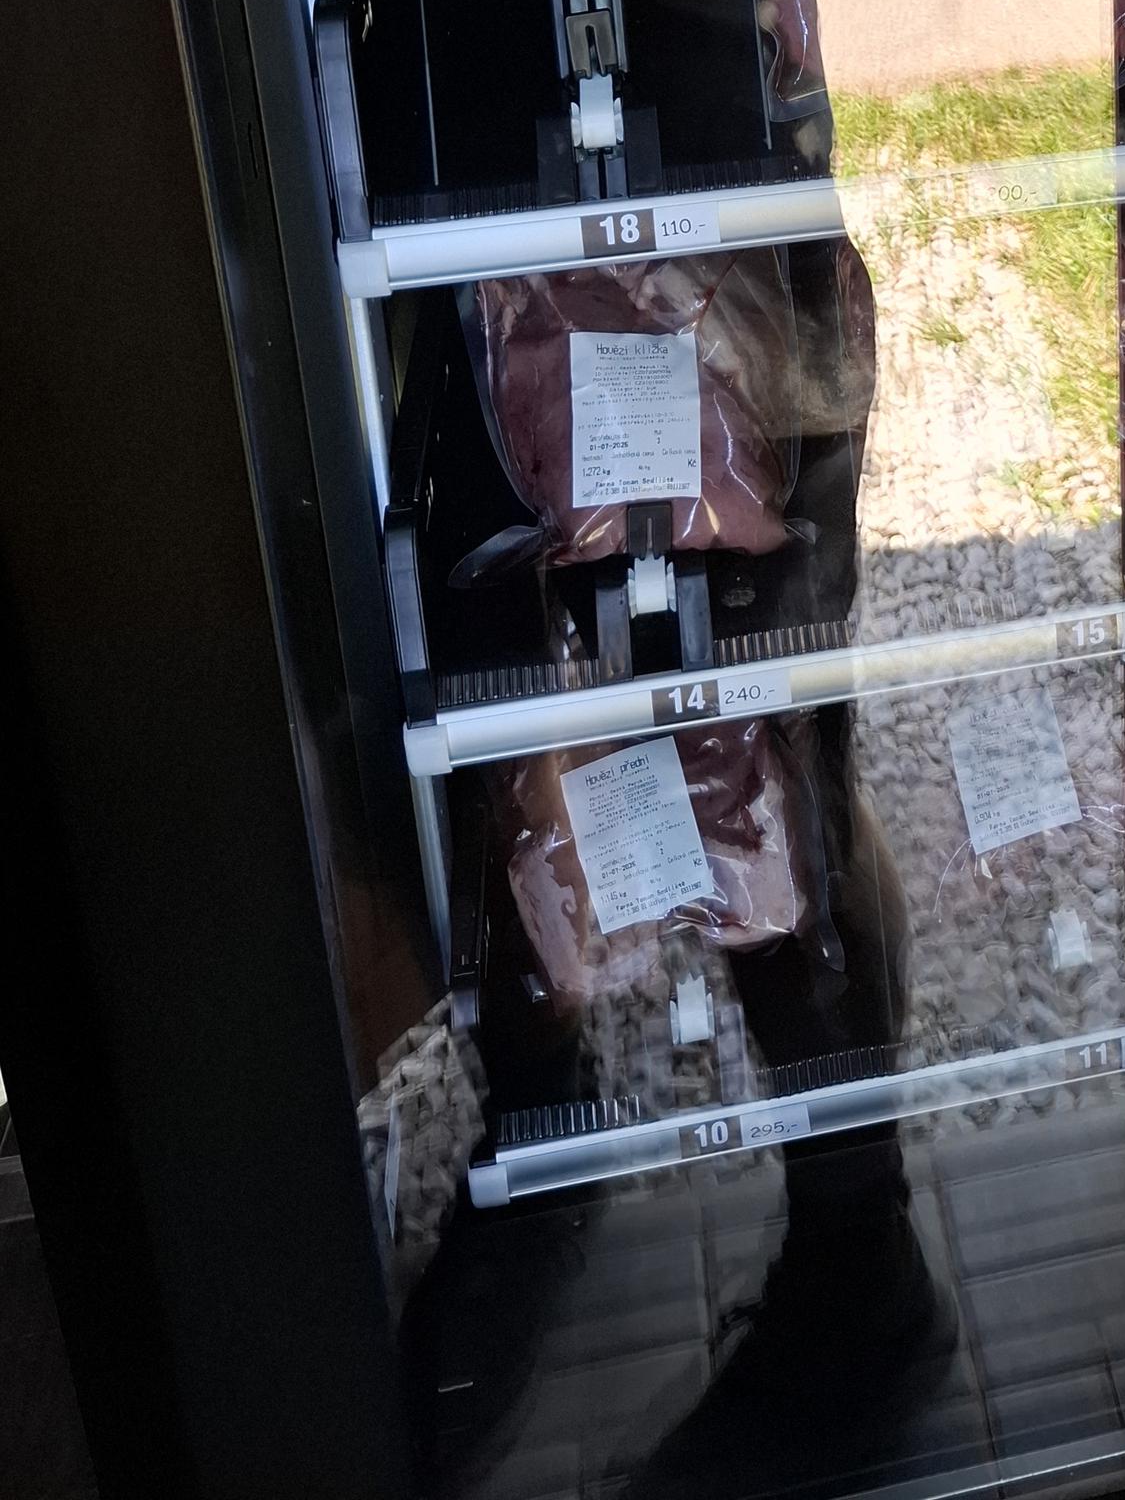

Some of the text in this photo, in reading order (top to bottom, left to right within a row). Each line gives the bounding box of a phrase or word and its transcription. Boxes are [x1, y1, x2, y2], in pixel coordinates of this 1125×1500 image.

[600, 213, 640, 246] 18
[661, 218, 706, 237] 110,-
[596, 343, 628, 355] Hovězí
[1072, 618, 1105, 646] 15
[668, 683, 706, 714] 14
[724, 685, 775, 704] 240,-
[585, 753, 650, 787] Hovězí přední
[1079, 1042, 1107, 1069] 11
[694, 1120, 729, 1148] 10
[750, 1121, 798, 1138] 295,-
